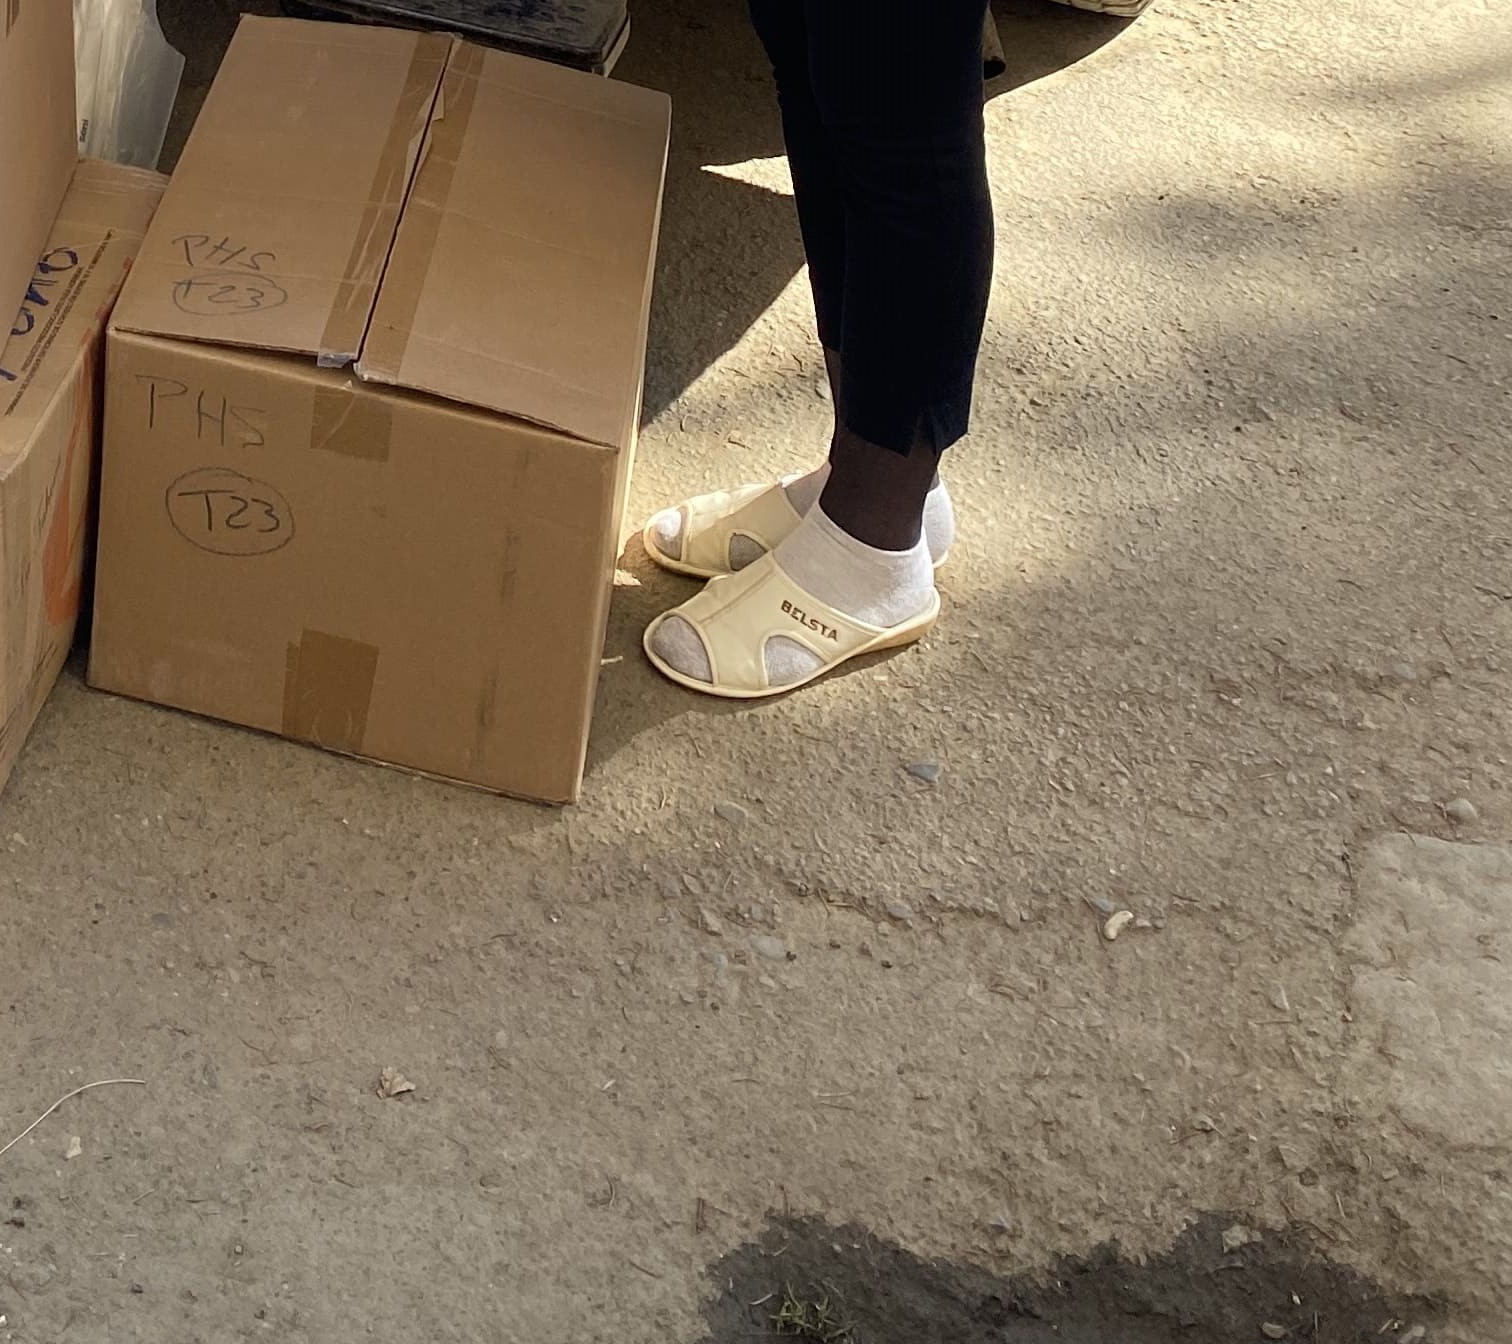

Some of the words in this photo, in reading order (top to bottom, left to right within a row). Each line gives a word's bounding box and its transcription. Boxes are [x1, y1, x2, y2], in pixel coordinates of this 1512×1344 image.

[135, 374, 267, 449] PHS
[178, 487, 282, 534] T23
[780, 599, 840, 642] BELSTA
